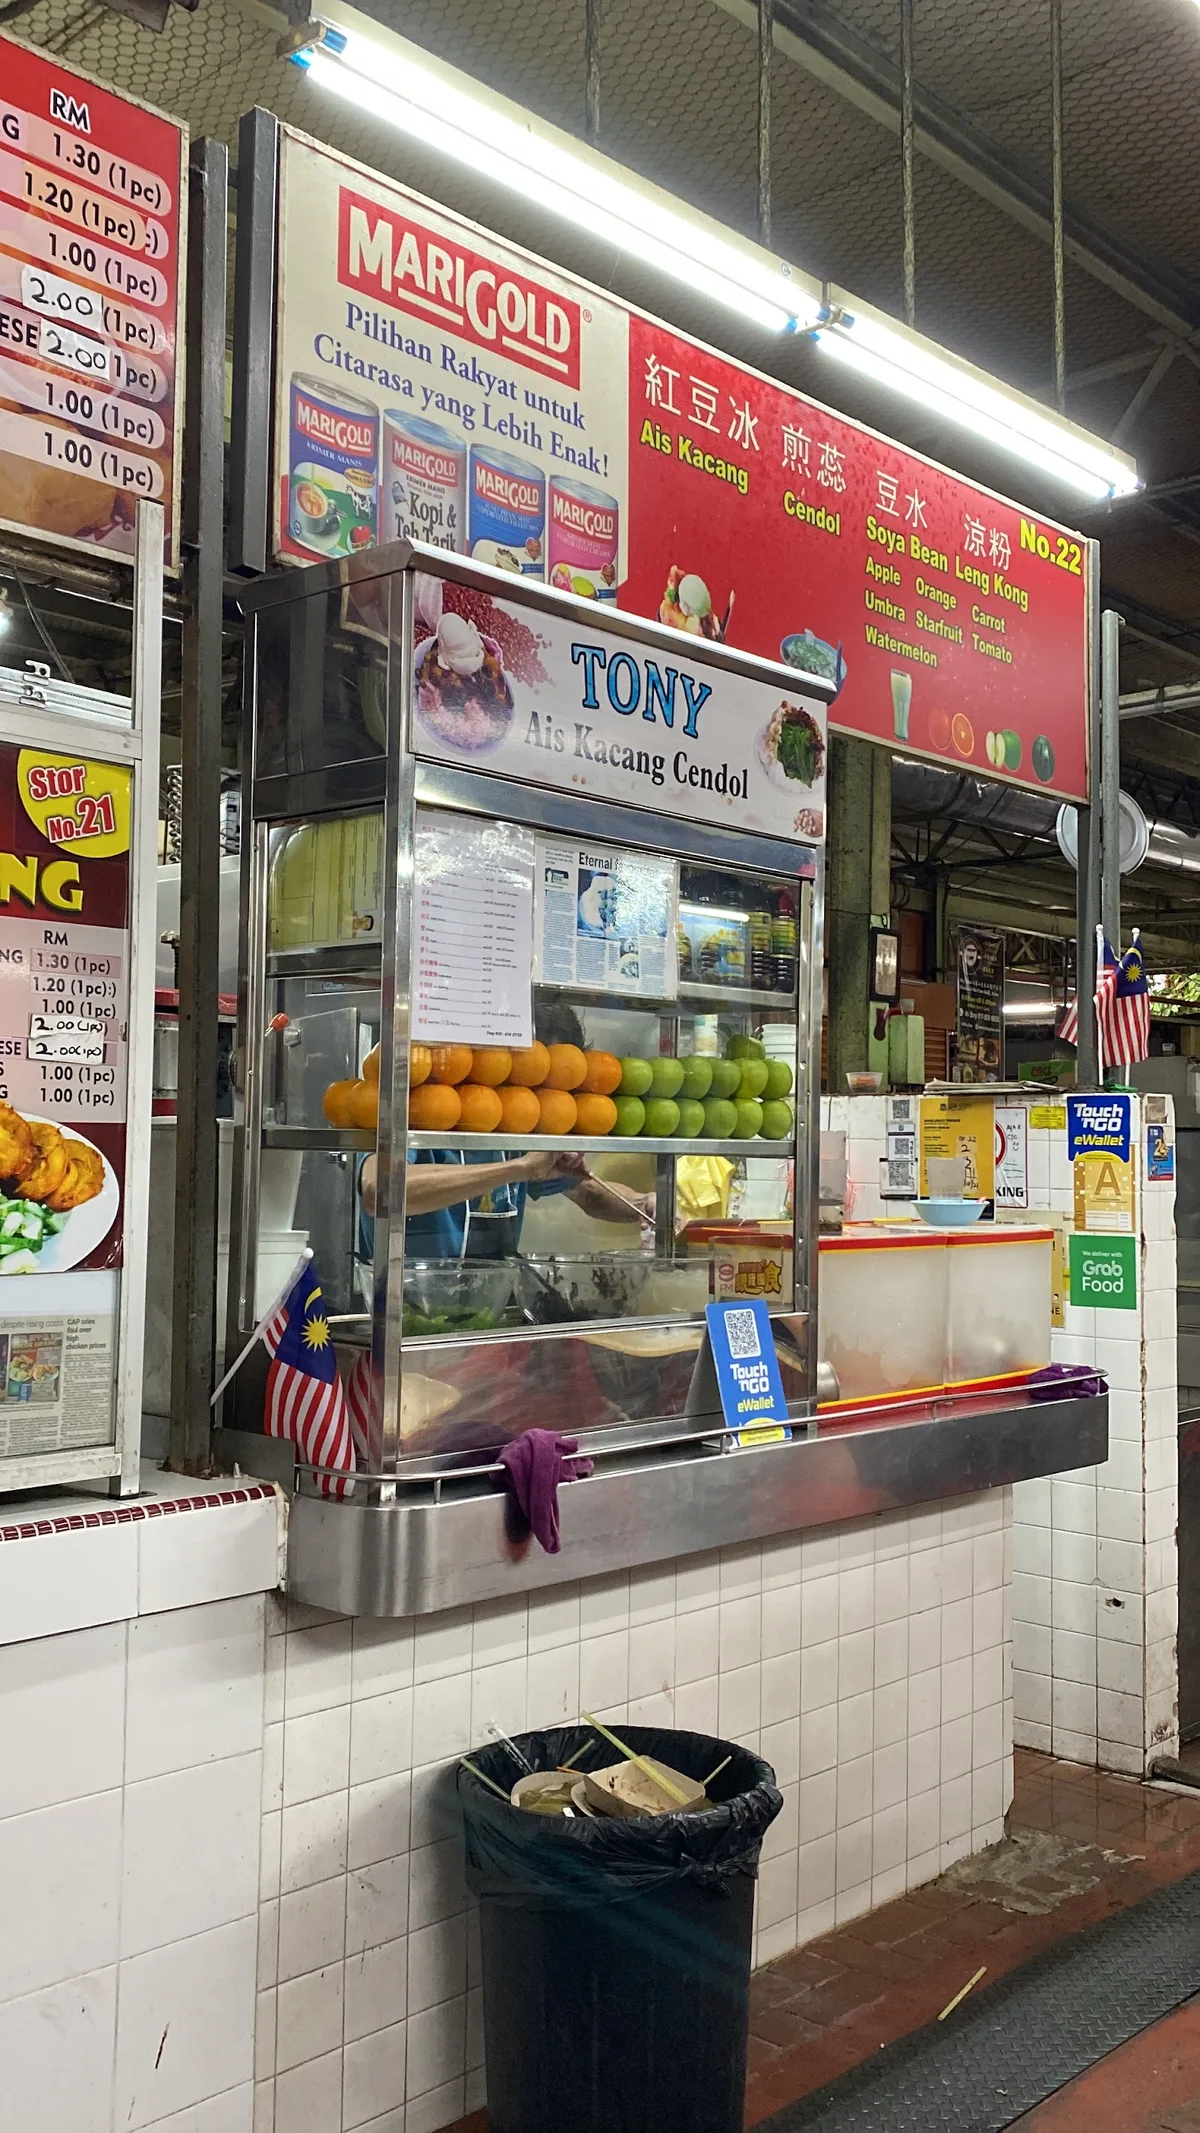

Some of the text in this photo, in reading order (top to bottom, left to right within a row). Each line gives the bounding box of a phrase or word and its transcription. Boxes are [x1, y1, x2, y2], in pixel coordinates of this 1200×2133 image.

[51, 88, 91, 133] RM
[53, 133, 100, 175] 1.30
[109, 163, 162, 209] (1pc)
[25, 172, 73, 213] 1.20
[82, 200, 136, 245] (1pc)
[49, 232, 157, 301] 1.00 (1pc)
[349, 204, 571, 353] MARIGOLD
[30, 277, 156, 349] 2.00 (1pc)
[47, 330, 107, 370] 2.00
[346, 302, 586, 430] Pilihan Rakyat untuk
[45, 382, 155, 444] 1.00 (1pc)
[314, 333, 608, 477] Citarasa yang Lebih Enak!
[645, 353, 760, 451] 紅豆冰
[298, 401, 371, 448] MARIGOLD
[44, 432, 153, 492] 1.00 (1pc)
[394, 440, 456, 477] MARIGOLD
[640, 419, 749, 495] Ais Kacang
[781, 423, 846, 493] 煎蕊
[476, 465, 539, 508] MARIGOLD
[876, 470, 928, 529] 豆水
[395, 512, 456, 552] Teh Tarik
[410, 491, 443, 529] Kopi
[447, 504, 456, 528] &
[554, 494, 614, 535] MARIGOLD
[783, 491, 841, 536] Cendol
[866, 515, 948, 572] Soya Bean
[1020, 518, 1082, 576] No.22
[865, 556, 1006, 633] Apple Orange Carrot
[955, 555, 1029, 613] Leng Kong
[865, 590, 1013, 665] Umbra Starfruit Tomato
[865, 624, 938, 668] Watermelon
[571, 643, 712, 739] TONY
[524, 711, 748, 799] Ais Kacang Cendol
[29, 766, 86, 800] Stor
[47, 795, 115, 844] No.21
[0, 854, 83, 911] NG
[579, 852, 613, 870] Eternal
[44, 930, 68, 946] RM
[33, 977, 65, 992] 1.20
[37, 953, 69, 969] 1.30
[75, 957, 111, 975] (1pc)
[34, 1017, 74, 1031] 2.00
[42, 999, 116, 1019] 1.00 (1pc)
[40, 1088, 72, 1102] 1.00
[78, 1090, 114, 1106] (1pc)
[41, 1066, 115, 1084] 1.00 (1pc)
[1074, 1103, 1123, 1118] Touch
[1074, 1134, 1124, 1146] eWallet
[1095, 1162, 1121, 1196] A
[1082, 1260, 1123, 1277] Grab
[1082, 1277, 1124, 1293] Food
[66, 1334, 79, 1342] high
[89, 1342, 106, 1350] prices
[730, 1361, 768, 1380] Touch
[738, 1395, 774, 1413] eWallet
